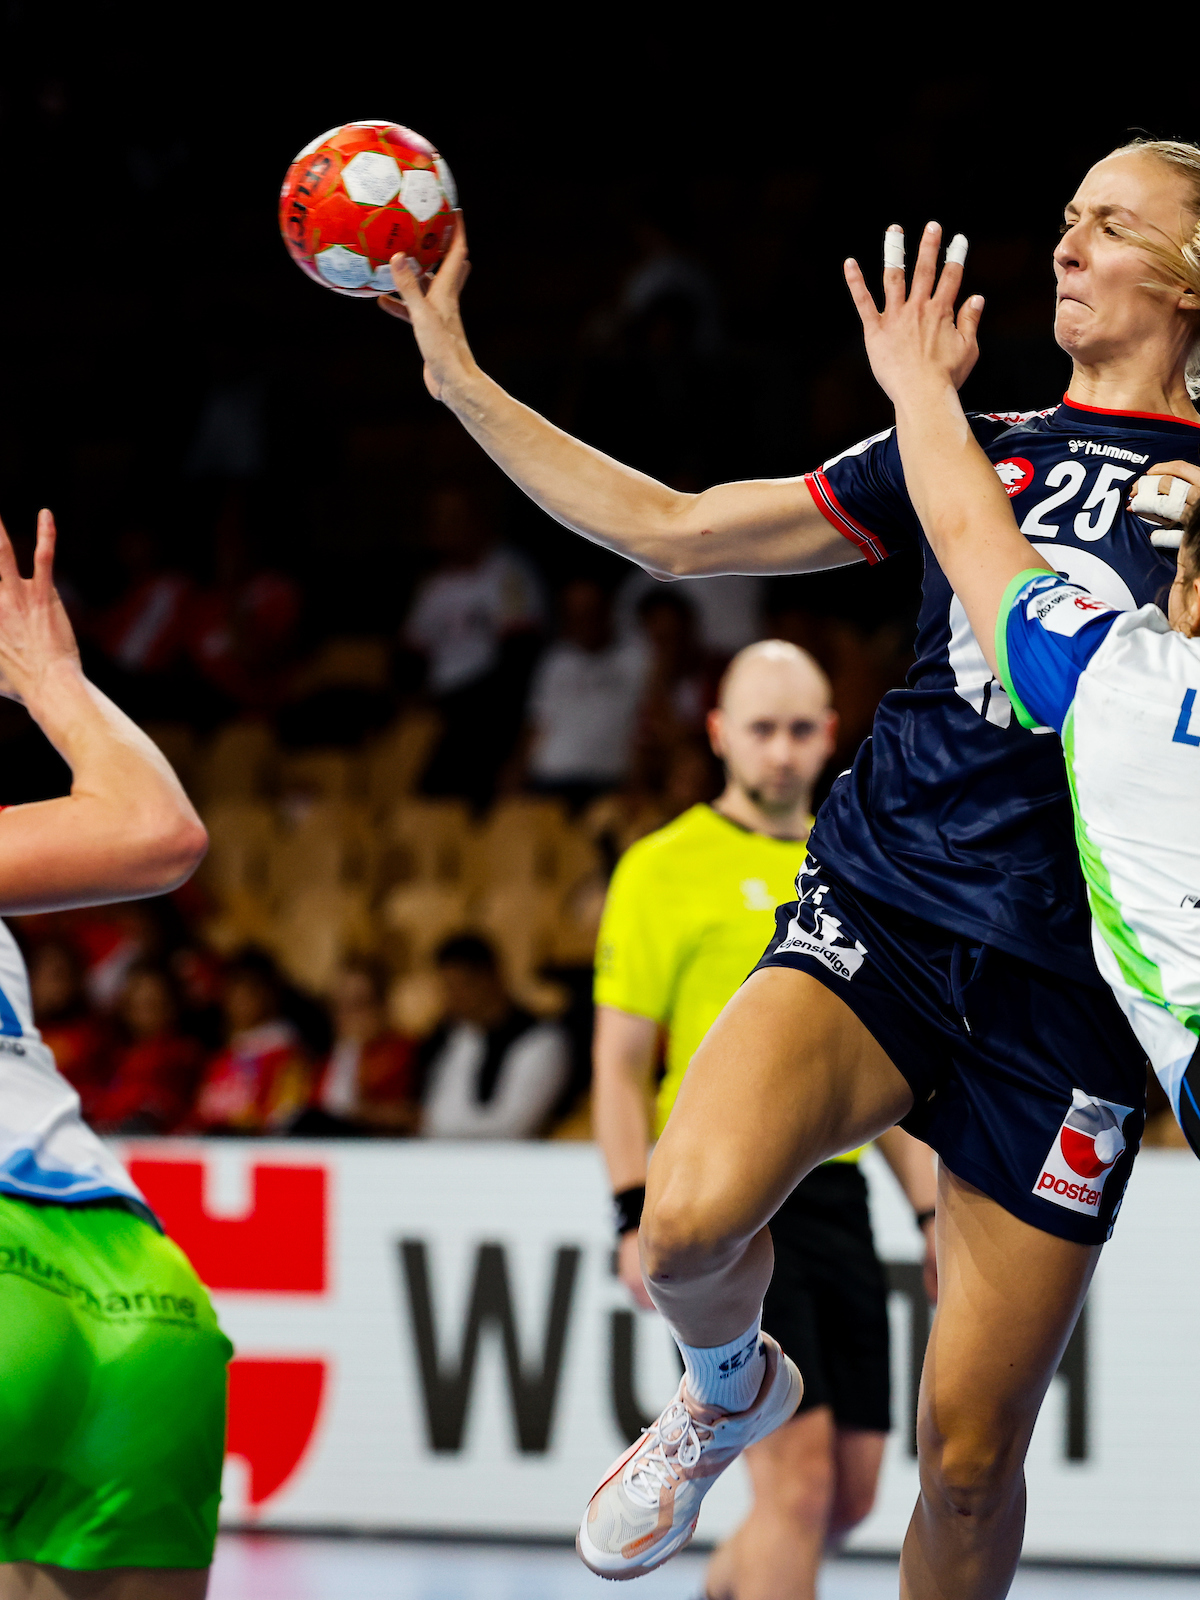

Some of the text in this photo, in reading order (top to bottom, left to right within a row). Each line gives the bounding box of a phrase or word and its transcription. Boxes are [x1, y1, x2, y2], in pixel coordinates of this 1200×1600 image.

[1084, 440, 1150, 465] hummel
[1004, 485, 1022, 495] HF
[1019, 459, 1137, 543] 25
